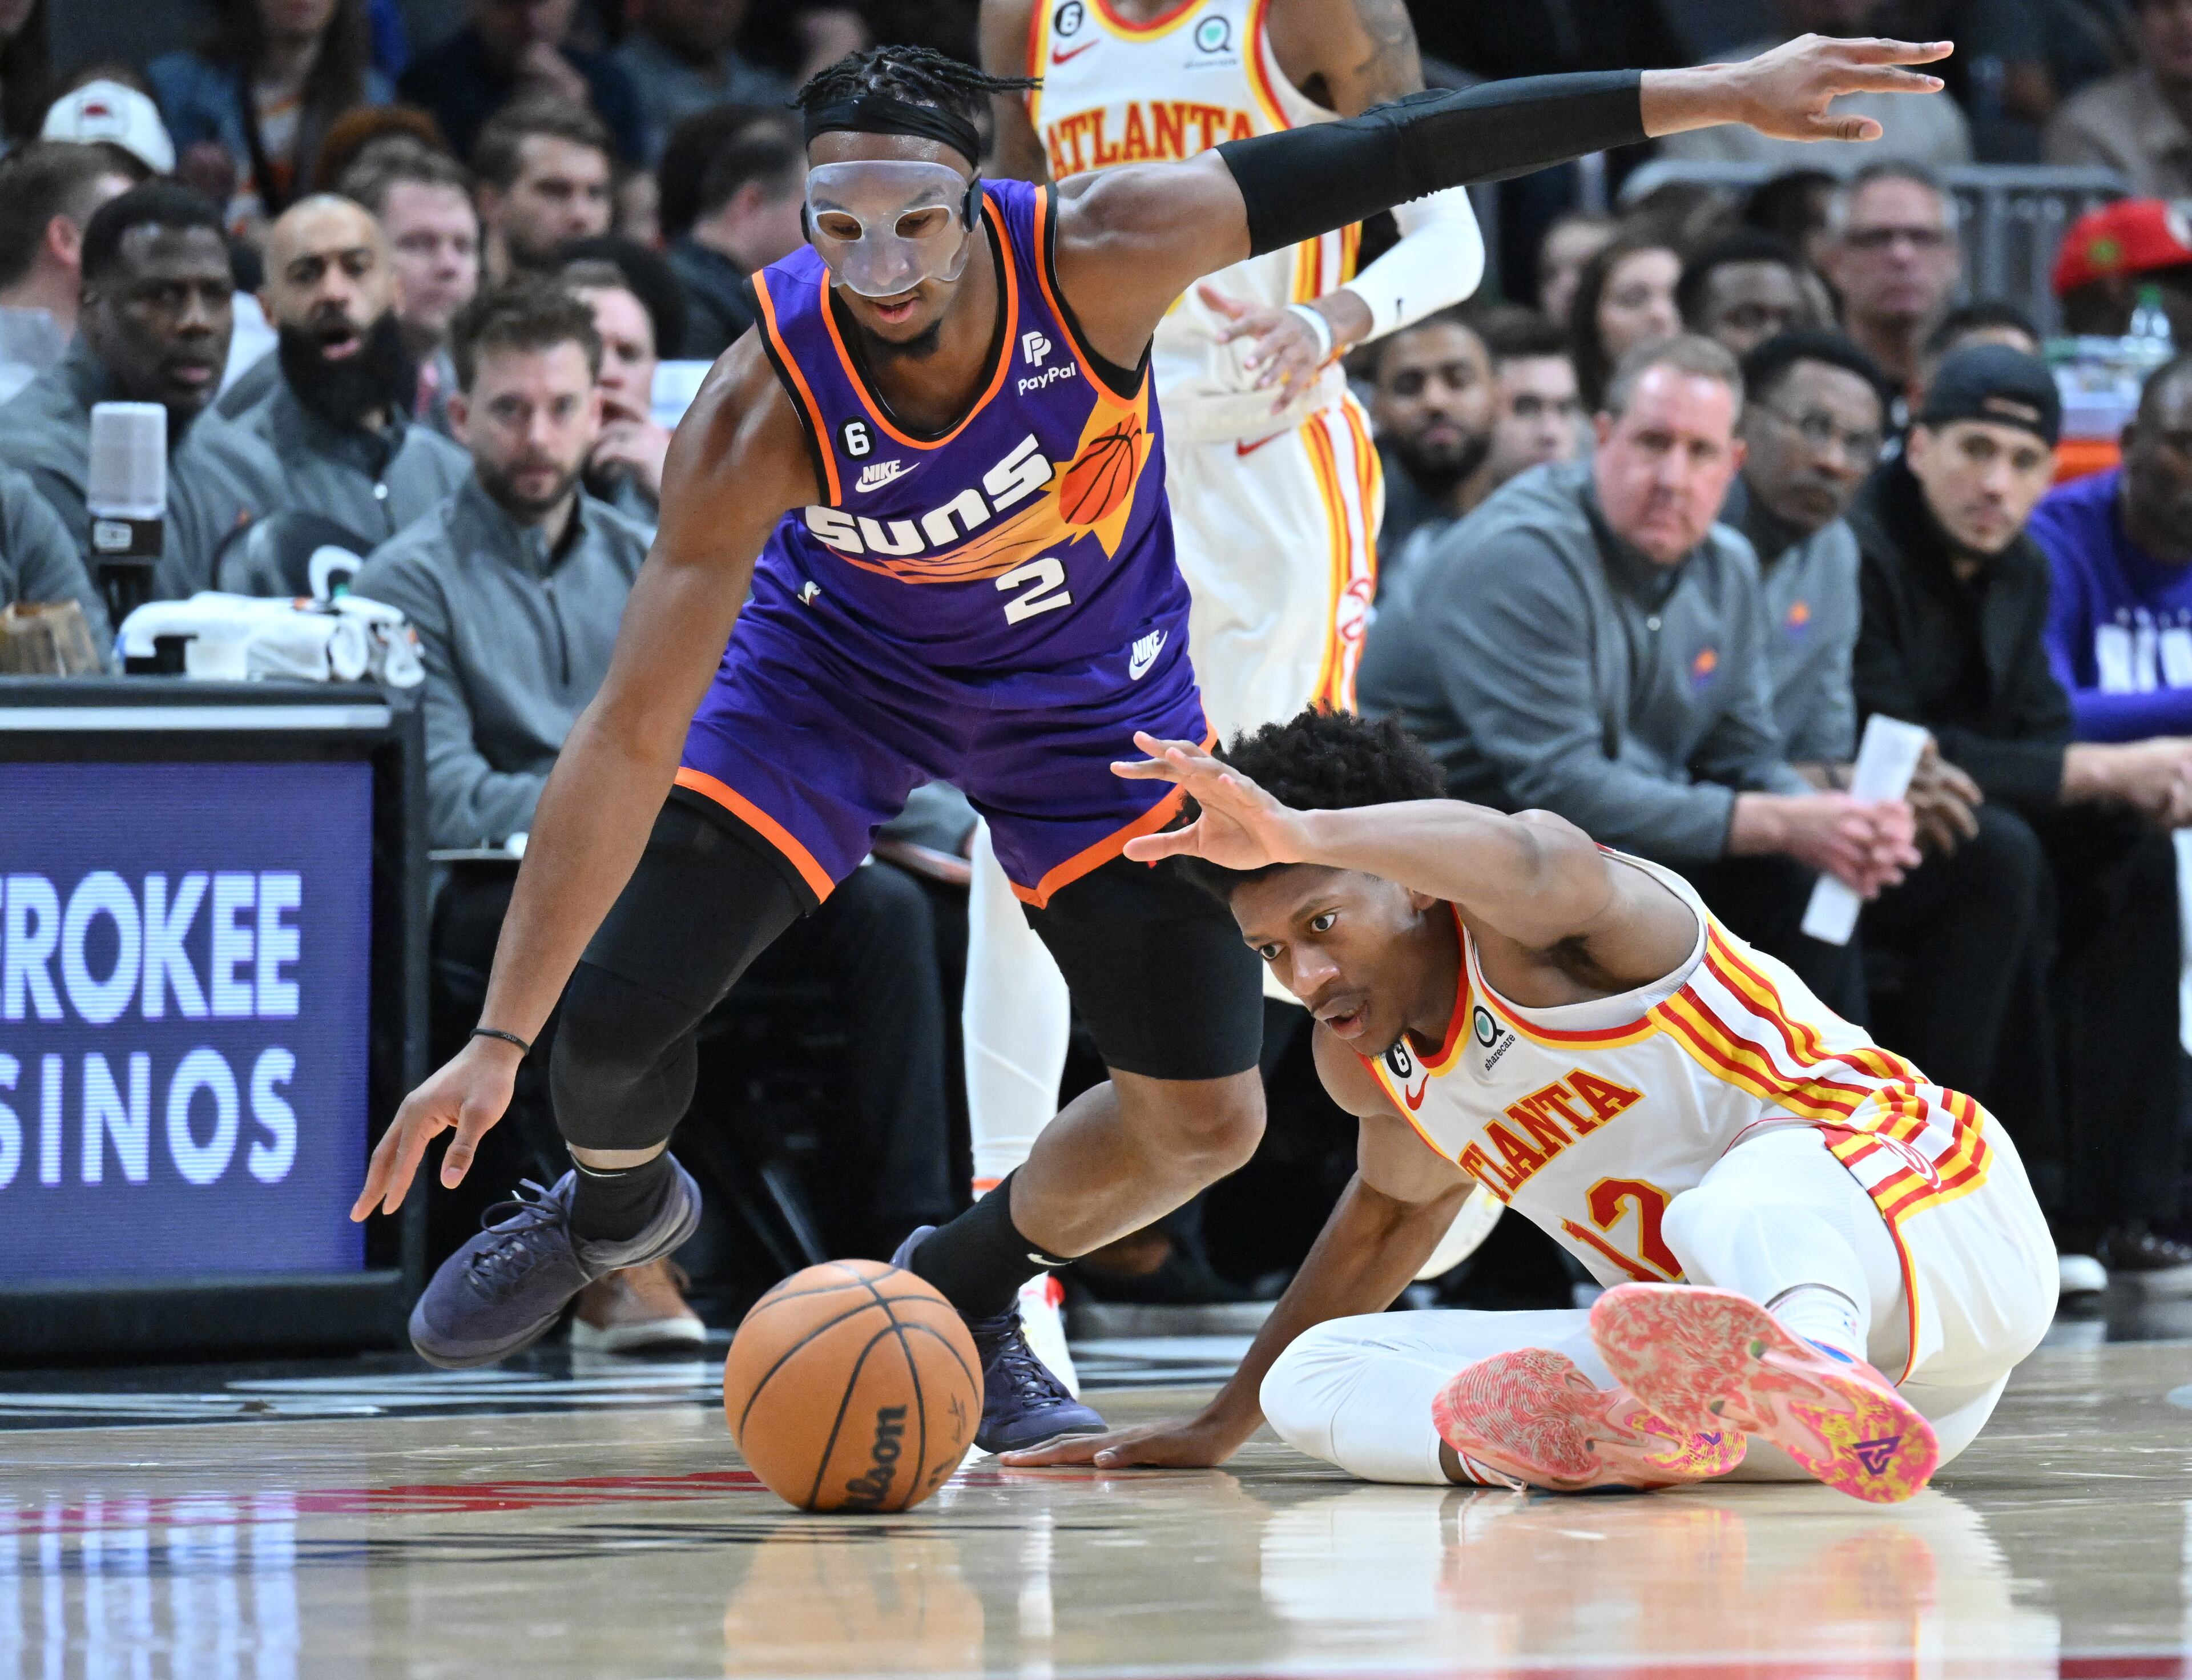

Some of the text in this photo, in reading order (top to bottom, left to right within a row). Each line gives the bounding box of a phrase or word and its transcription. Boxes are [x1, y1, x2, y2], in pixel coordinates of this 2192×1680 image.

[1018, 362, 1076, 396] PayPal
[844, 422, 870, 456] 6
[863, 460, 901, 484] NIKE
[995, 557, 1074, 626] 2
[0, 871, 301, 1024] ROKEE
[1393, 1044, 1409, 1073] 6
[1485, 1034, 1516, 1071] sharecare
[1556, 1176, 1686, 1283] 12
